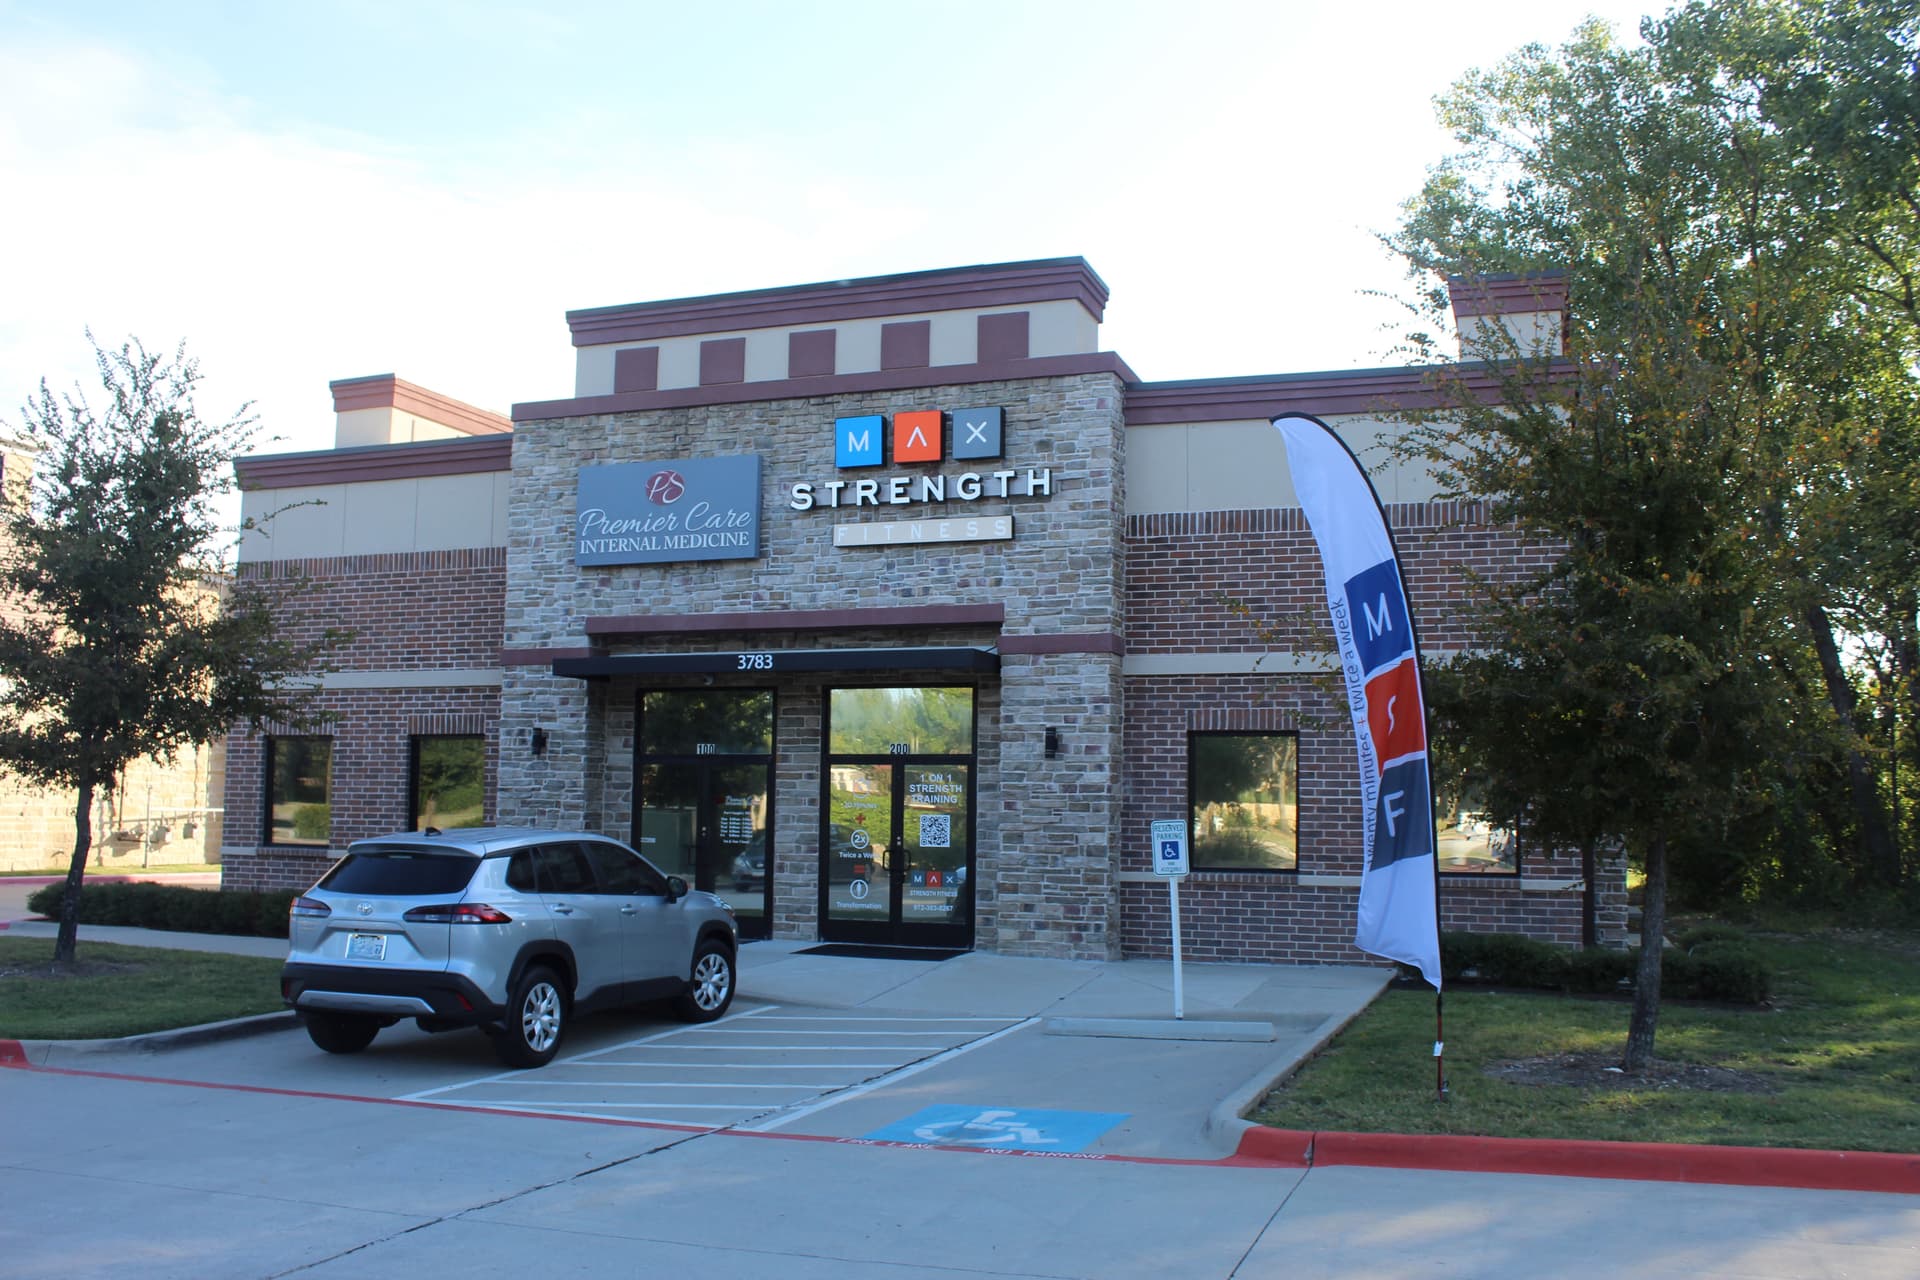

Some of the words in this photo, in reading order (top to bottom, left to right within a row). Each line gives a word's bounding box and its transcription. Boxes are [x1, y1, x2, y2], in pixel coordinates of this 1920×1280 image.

[790, 468, 1051, 511] STRENGTH
[578, 508, 680, 537] Premier
[685, 501, 752, 533] Care
[837, 519, 1007, 542] FITNESS
[579, 536, 661, 554] INTERNAL
[663, 531, 750, 550] MEDICINE
[1330, 597, 1351, 645] week
[1344, 650, 1355, 660] a
[737, 654, 773, 670] 3783
[1347, 665, 1365, 713] twice
[1362, 592, 1393, 642] M
[1383, 790, 1405, 838] F
[696, 743, 715, 755] 100
[890, 743, 909, 755] 200
[1360, 732, 1377, 801] minutes
[920, 774, 925, 783] 1
[929, 774, 943, 783] ON
[947, 774, 952, 783] 1
[909, 784, 963, 793] STRENGTH
[911, 794, 958, 804] TRAINING
[1152, 824, 1184, 832] RESERVED
[854, 833, 866, 844] 2x
[836, 901, 882, 910] Transformation
[1022, 1151, 1107, 1160] PARKING
